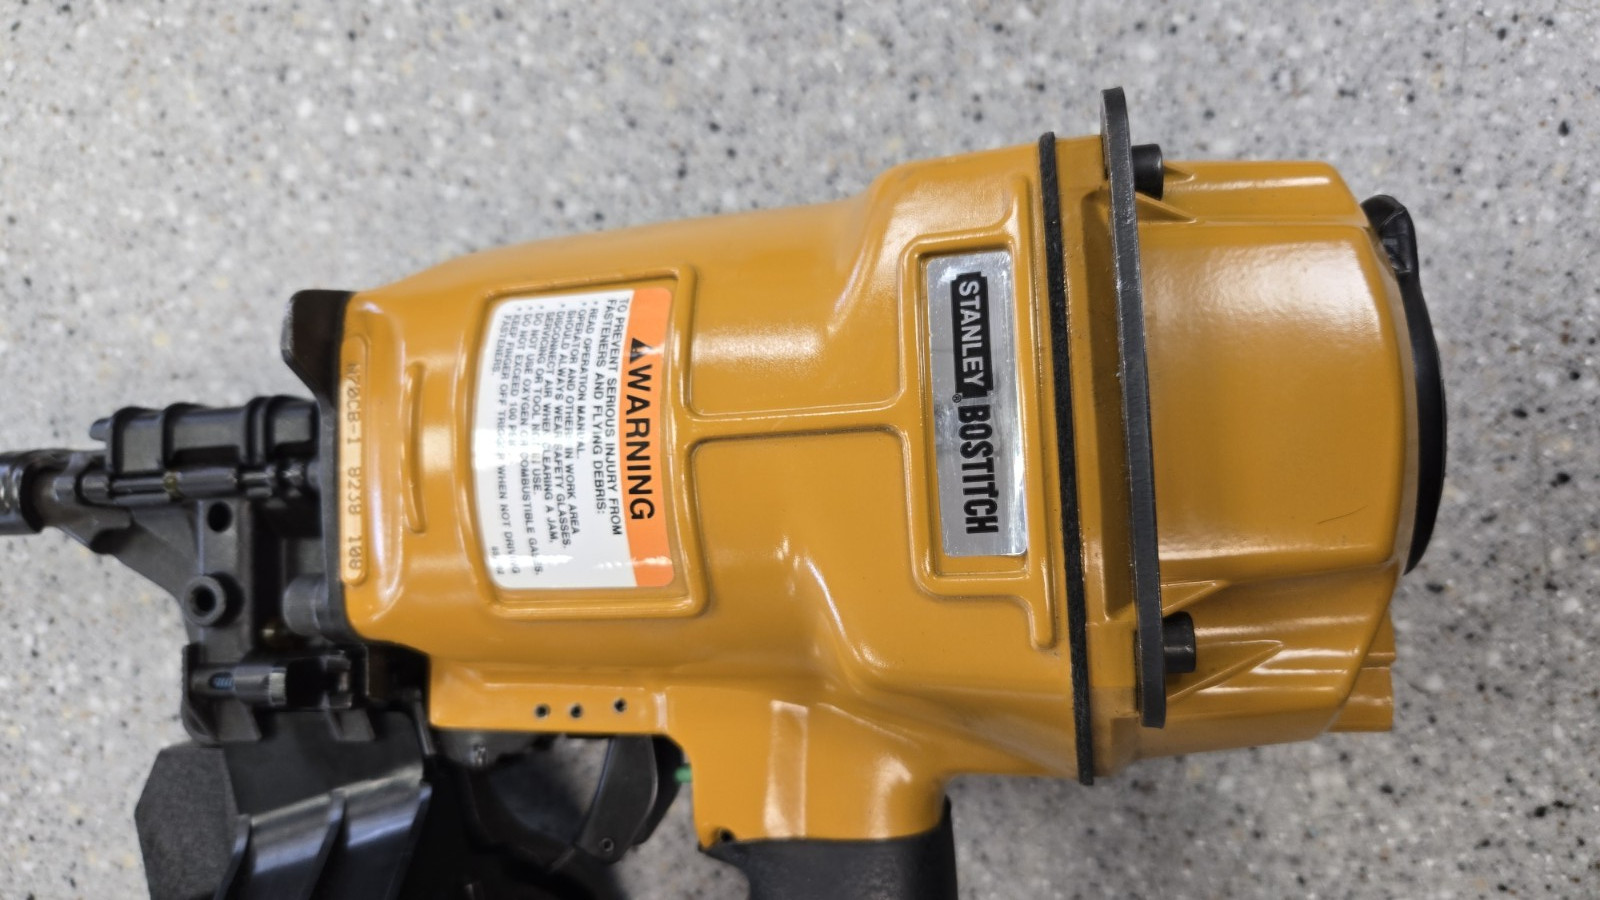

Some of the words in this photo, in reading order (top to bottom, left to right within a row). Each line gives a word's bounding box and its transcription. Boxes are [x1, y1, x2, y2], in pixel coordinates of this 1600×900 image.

[522, 314, 532, 327] DO
[533, 313, 544, 326] DO
[586, 308, 598, 334] READ
[618, 298, 629, 312] TO
[509, 315, 521, 338] KEEP
[517, 331, 527, 350] NOT
[529, 330, 539, 349] NOT
[537, 312, 555, 364] SERVICING
[547, 311, 565, 375] DISCONNECT
[561, 310, 576, 350] SHOULD
[570, 309, 586, 363] OPERATOR
[596, 299, 616, 367] FASTENERS
[609, 317, 625, 372] PREVENT
[959, 281, 985, 387] STANLEY
[501, 343, 514, 380] FINGER
[510, 355, 523, 396] EXCEED
[524, 354, 534, 374] USE
[535, 369, 544, 383] OR
[555, 354, 567, 400] ALWAYS
[567, 369, 576, 390] AND
[578, 338, 592, 400] OPERATION
[499, 384, 508, 405] OFF
[520, 379, 531, 425] OXYGEN
[532, 388, 542, 419] TOOL
[544, 380, 553, 397] AIR
[594, 373, 605, 400] AND
[509, 402, 517, 420] 100
[554, 405, 562, 438] WEAR
[565, 396, 574, 441] OTHER
[605, 378, 617, 437] SERIOUS
[593, 406, 602, 454] FLYING
[626, 364, 655, 520] WARNING
[542, 442, 553, 500] CLEARING
[553, 444, 564, 488] SAFETY
[565, 448, 573, 459] IN
[606, 443, 618, 492] INJURY
[957, 405, 999, 534] BOSTITCH
[497, 466, 507, 499] WHEN
[520, 452, 535, 533] COMBUSTIBLE
[532, 469, 542, 495] USE.
[565, 464, 576, 499] WORK
[593, 461, 606, 514] DEBRIS:
[500, 504, 511, 527] NOT
[546, 505, 554, 513] A
[556, 494, 571, 548] GLASSES.
[570, 504, 579, 534] AREA
[609, 498, 622, 535] FROM
[547, 517, 558, 542] JAM,
